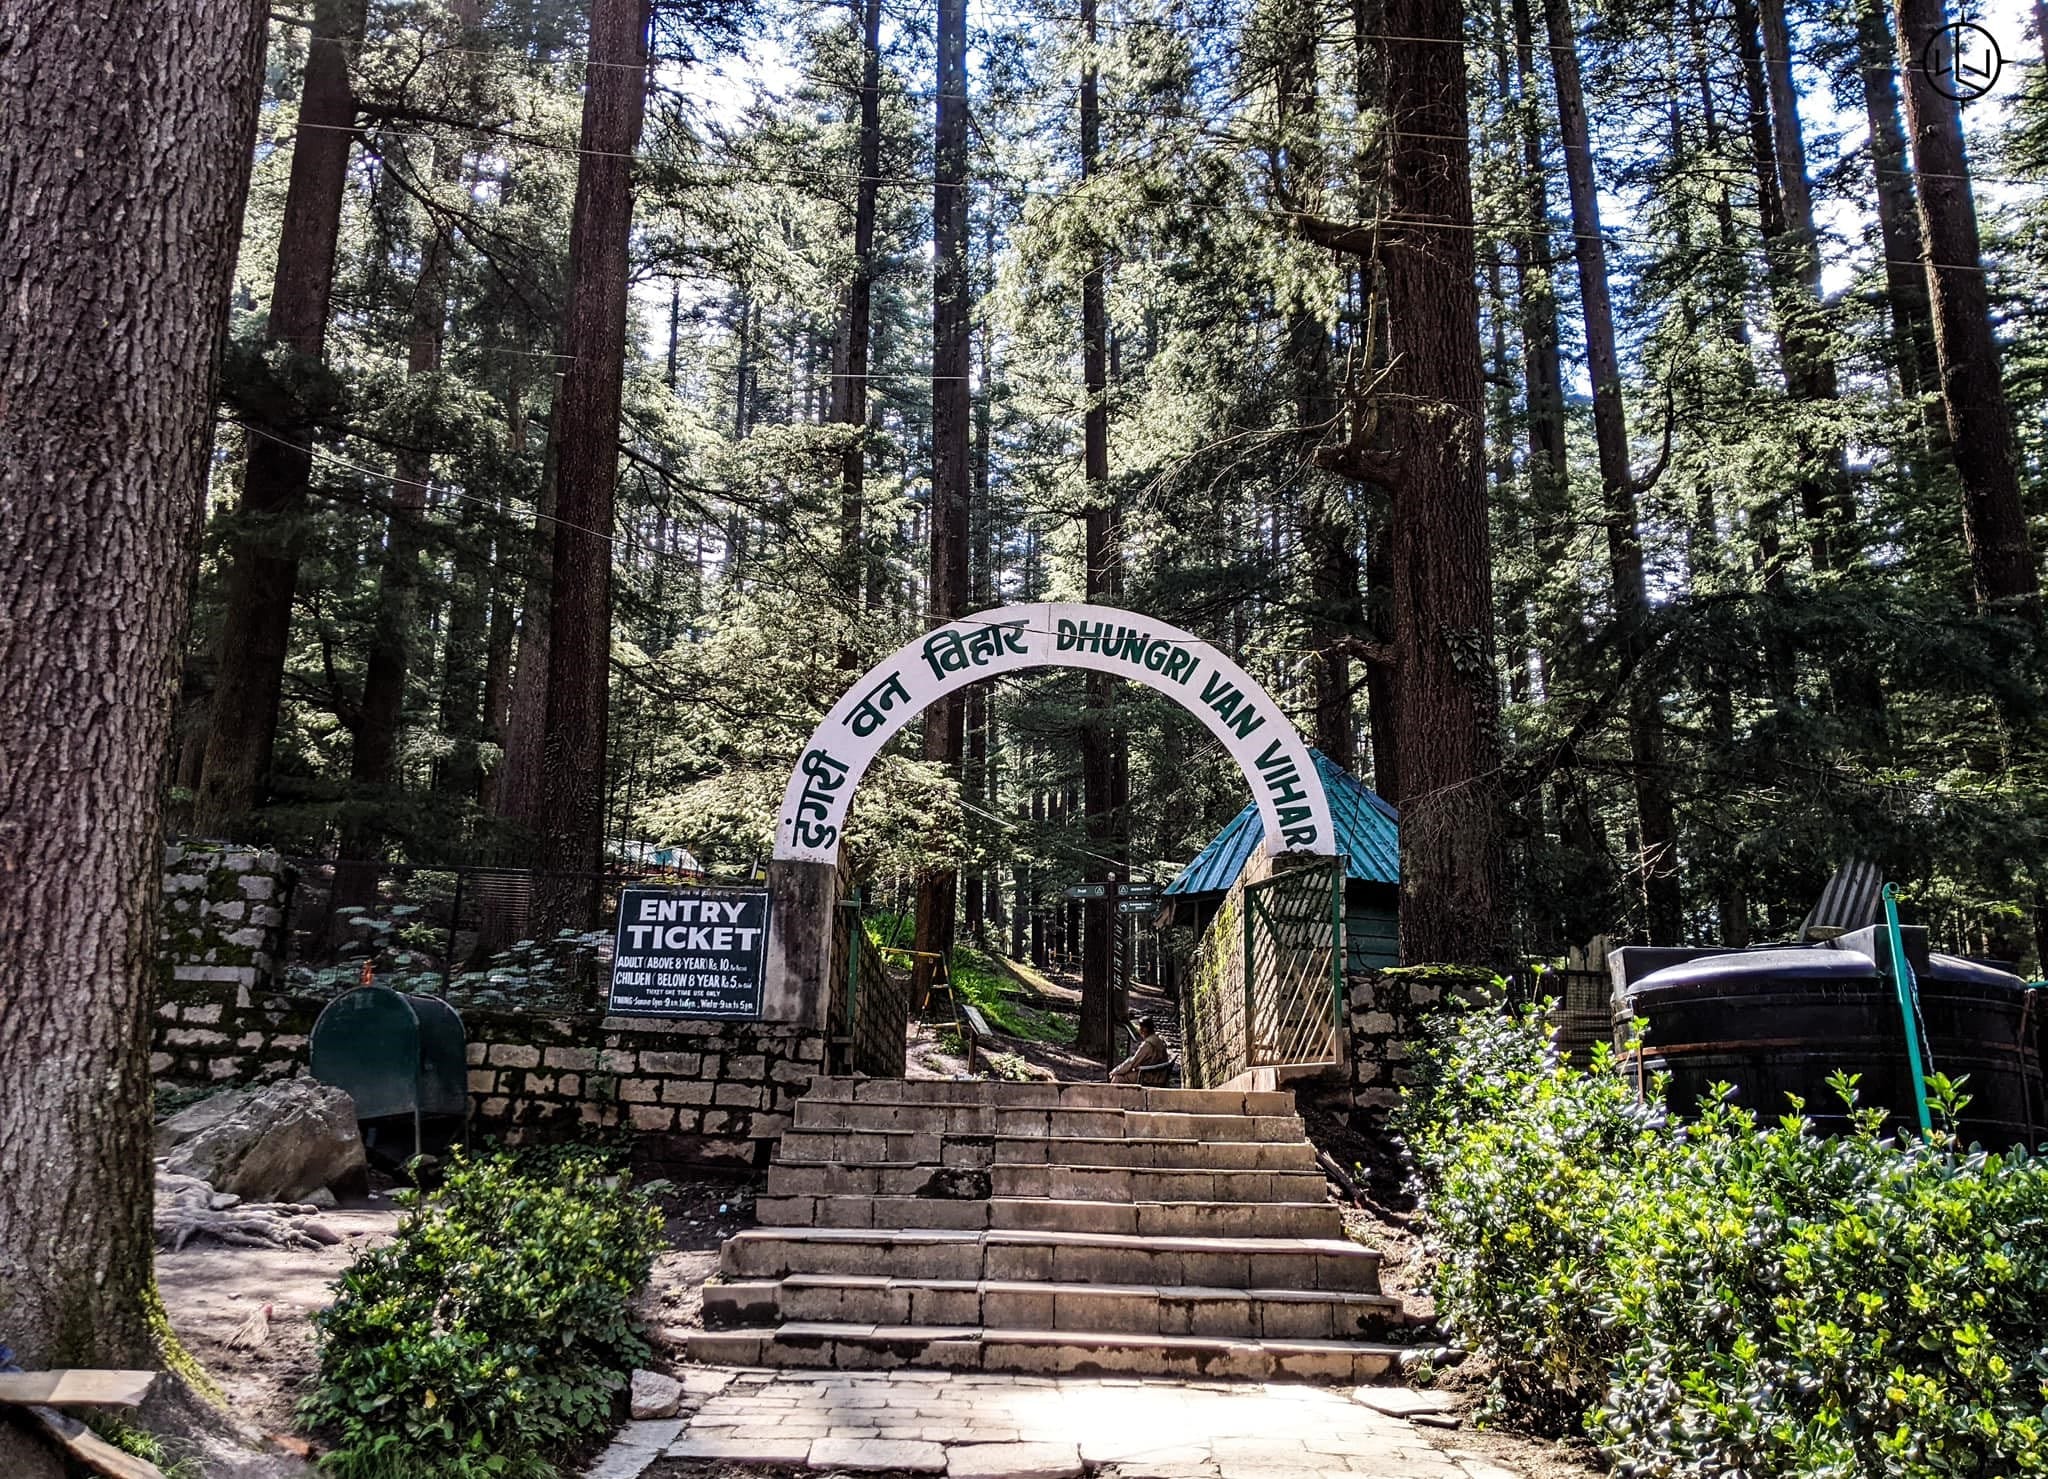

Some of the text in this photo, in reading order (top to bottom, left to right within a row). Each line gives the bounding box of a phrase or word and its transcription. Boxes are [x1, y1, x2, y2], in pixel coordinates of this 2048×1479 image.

[842, 671, 911, 738] वन
[920, 619, 1030, 681] विहार
[1056, 618, 1318, 851] DHUNGRI VAN VIHAR
[639, 899, 748, 923] ENTRY
[627, 925, 761, 951] TICKET
[617, 956, 644, 968] ADULT
[688, 974, 695, 987] 8
[696, 974, 720, 988] YEAR
